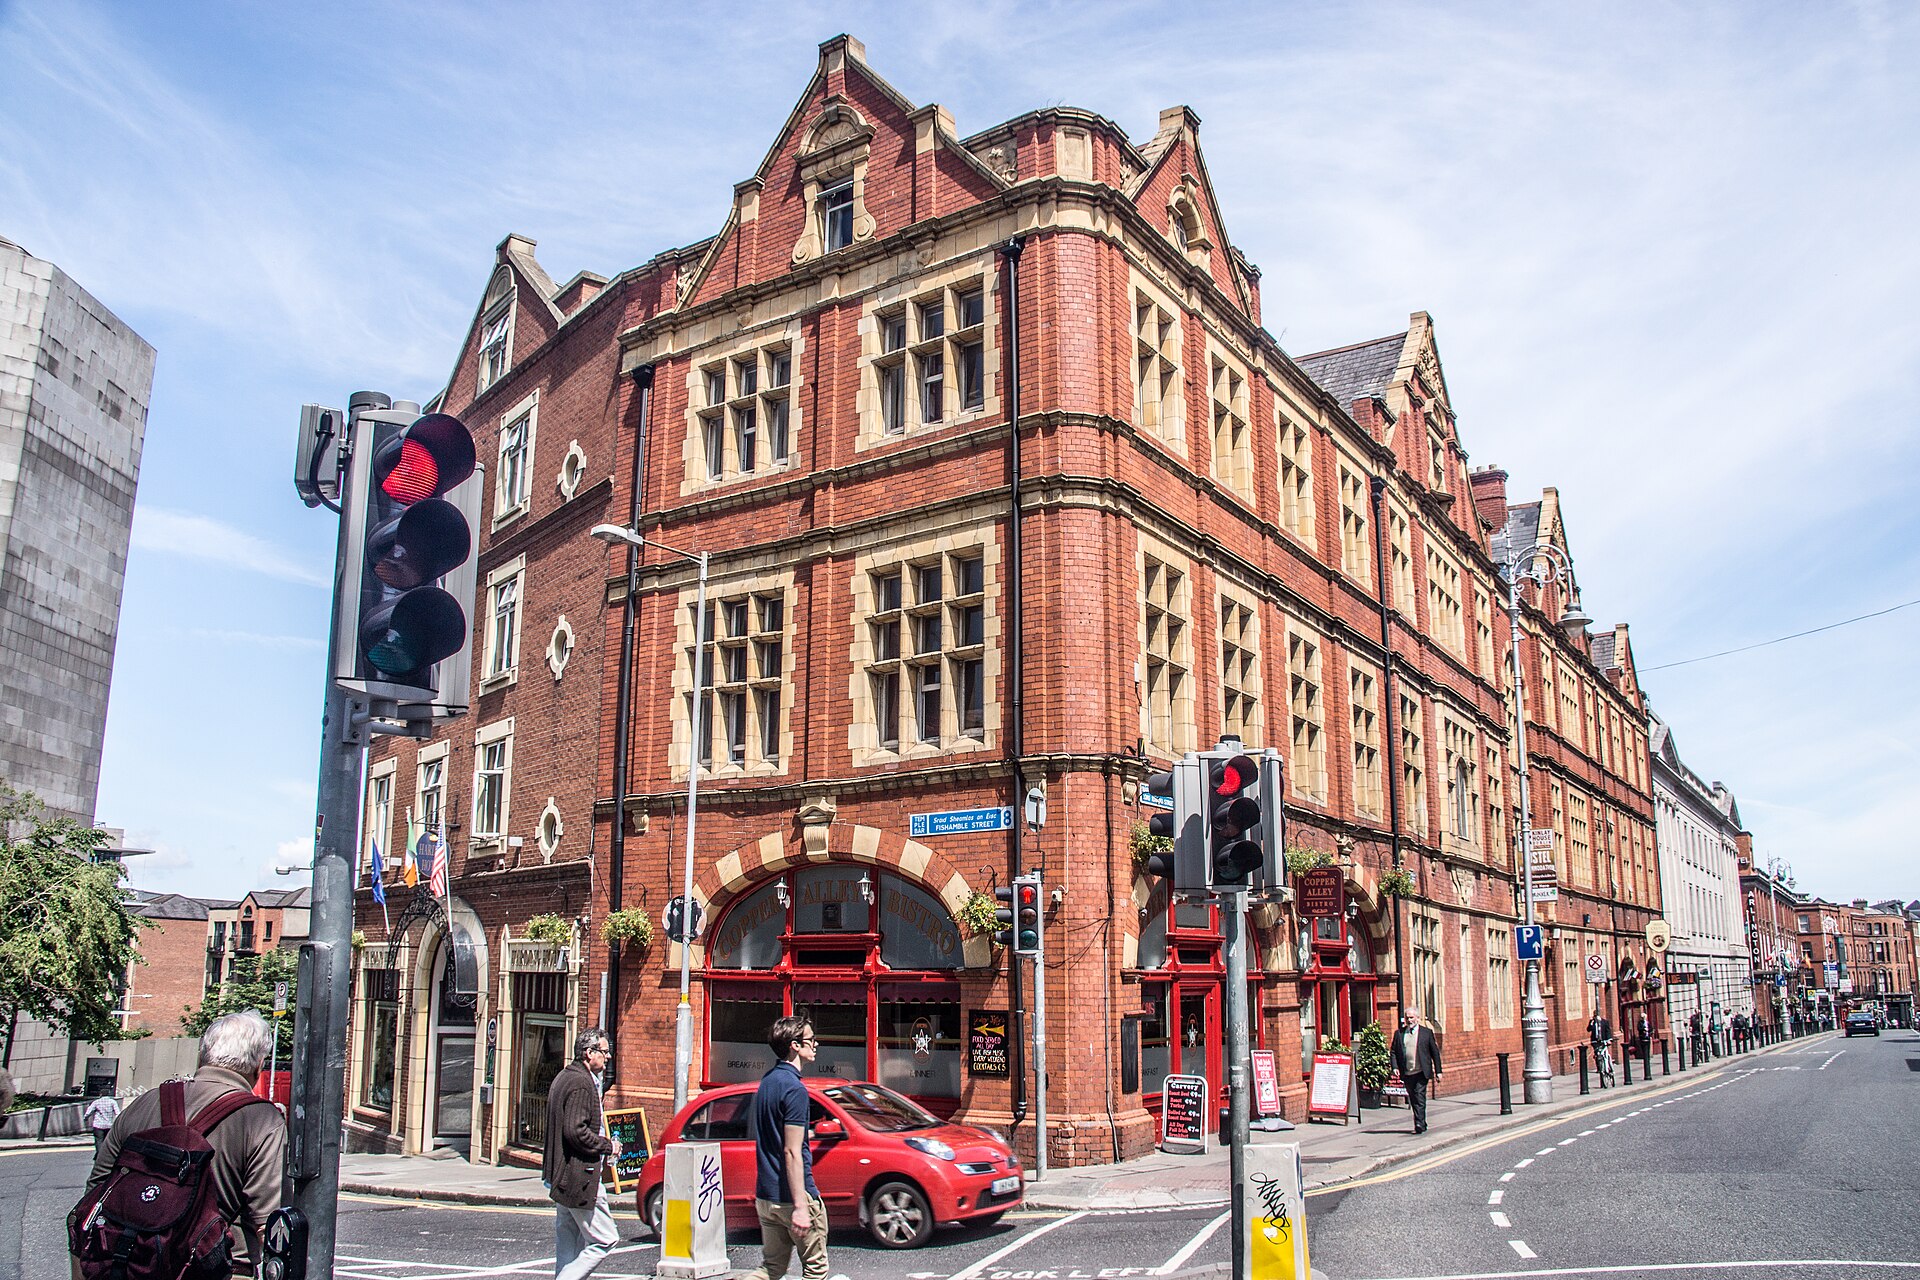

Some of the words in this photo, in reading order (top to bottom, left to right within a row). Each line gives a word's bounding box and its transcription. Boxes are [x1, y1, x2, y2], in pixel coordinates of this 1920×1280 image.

[1003, 810, 1012, 826] 8
[935, 823, 968, 831] FISHAMBLE
[972, 820, 994, 829] STREET
[1304, 877, 1336, 886] COPPER
[1307, 888, 1333, 896] ALLEY
[719, 894, 783, 961] COPPER
[803, 879, 861, 906] ALLEY
[886, 888, 956, 956] BISTRO
[1748, 890, 1760, 963] ARLINGTON
[1522, 927, 1534, 943] P
[972, 1036, 984, 1044] FOOD
[727, 1060, 766, 1069] BREAKFAST
[973, 1062, 997, 1071] COCKTAILS
[818, 1065, 842, 1074] LUNCH
[1170, 1082, 1199, 1091] Carvery
[966, 1269, 1059, 1280] LOOK
[1069, 1267, 1162, 1278] LEFT
